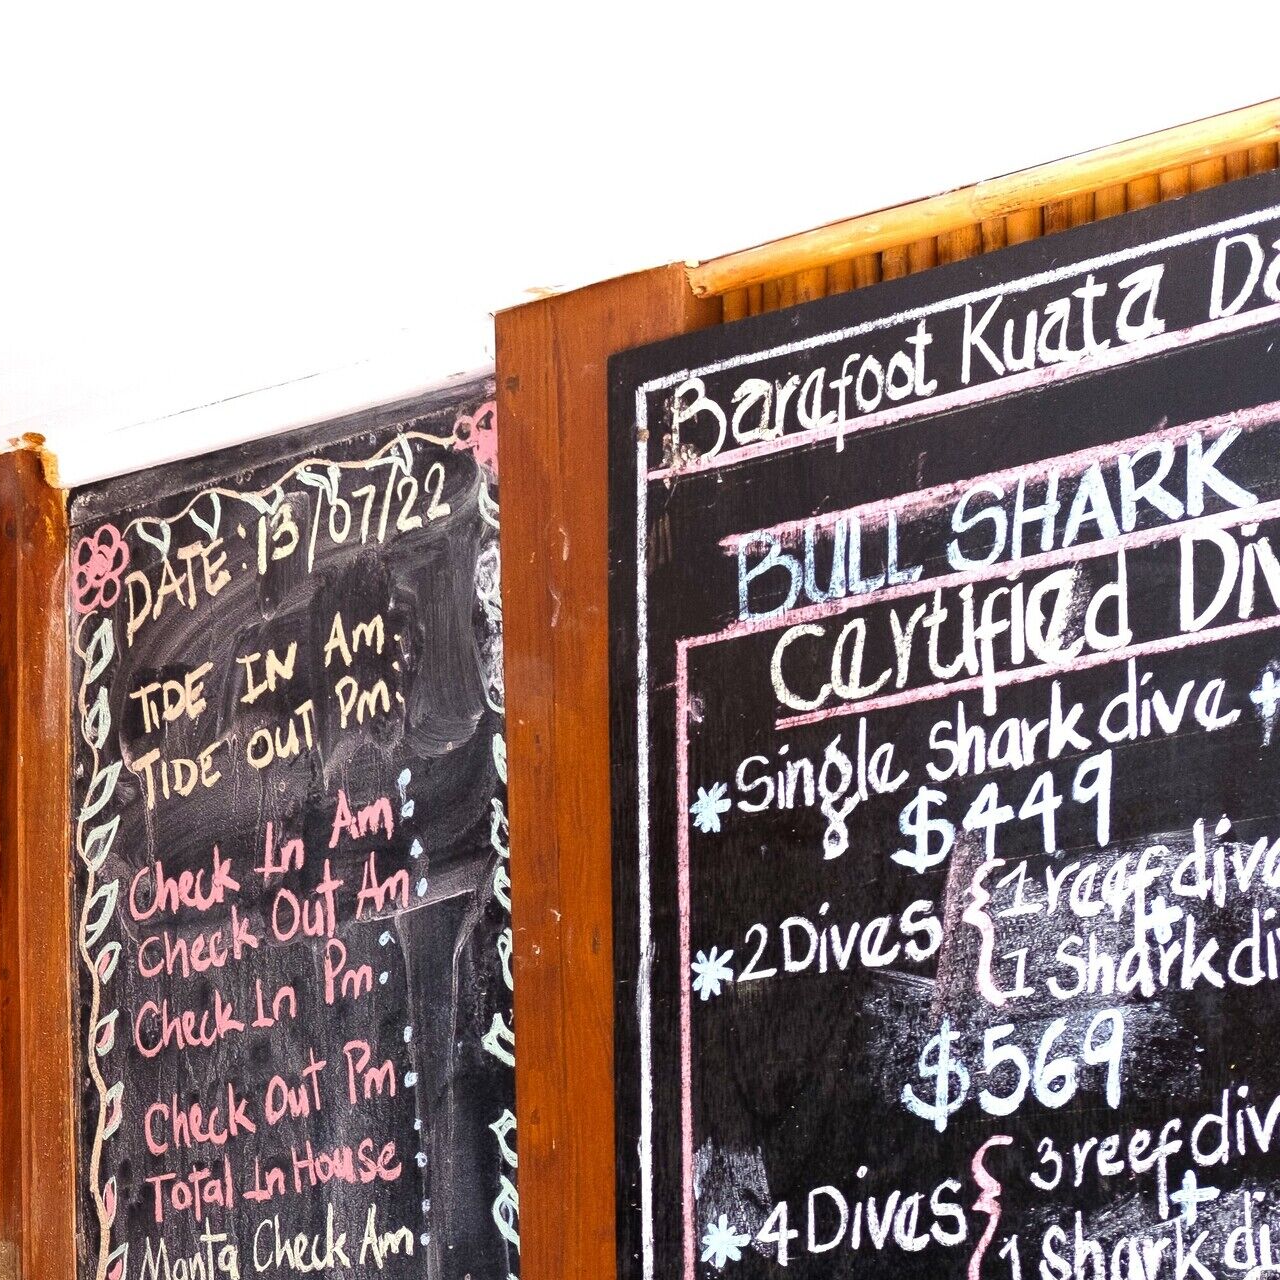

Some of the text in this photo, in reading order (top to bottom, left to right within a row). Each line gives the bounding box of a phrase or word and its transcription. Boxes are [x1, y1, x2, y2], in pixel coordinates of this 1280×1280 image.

[670, 317, 937, 458] Barefoot
[960, 262, 1166, 385] Kuata
[739, 425, 1260, 623] BULL SHARK
[130, 661, 214, 734] TIDE
[236, 640, 298, 704] IN
[770, 546, 1133, 716] Certified
[133, 740, 223, 810] TIDE
[246, 699, 314, 770] OUT
[736, 717, 909, 860] Single
[1097, 656, 1242, 743] dive
[891, 748, 1114, 875] $449
[129, 844, 242, 921] Check
[254, 821, 305, 874] In
[138, 905, 258, 978] Check
[271, 858, 344, 941] Out
[134, 991, 245, 1057] Check
[251, 980, 297, 1028] In
[902, 1008, 1125, 1132] $569
[144, 1083, 256, 1155] Check
[265, 1048, 328, 1125] Out
[146, 1153, 234, 1223] Total
[243, 1154, 286, 1202] In
[253, 1203, 351, 1273] Check
